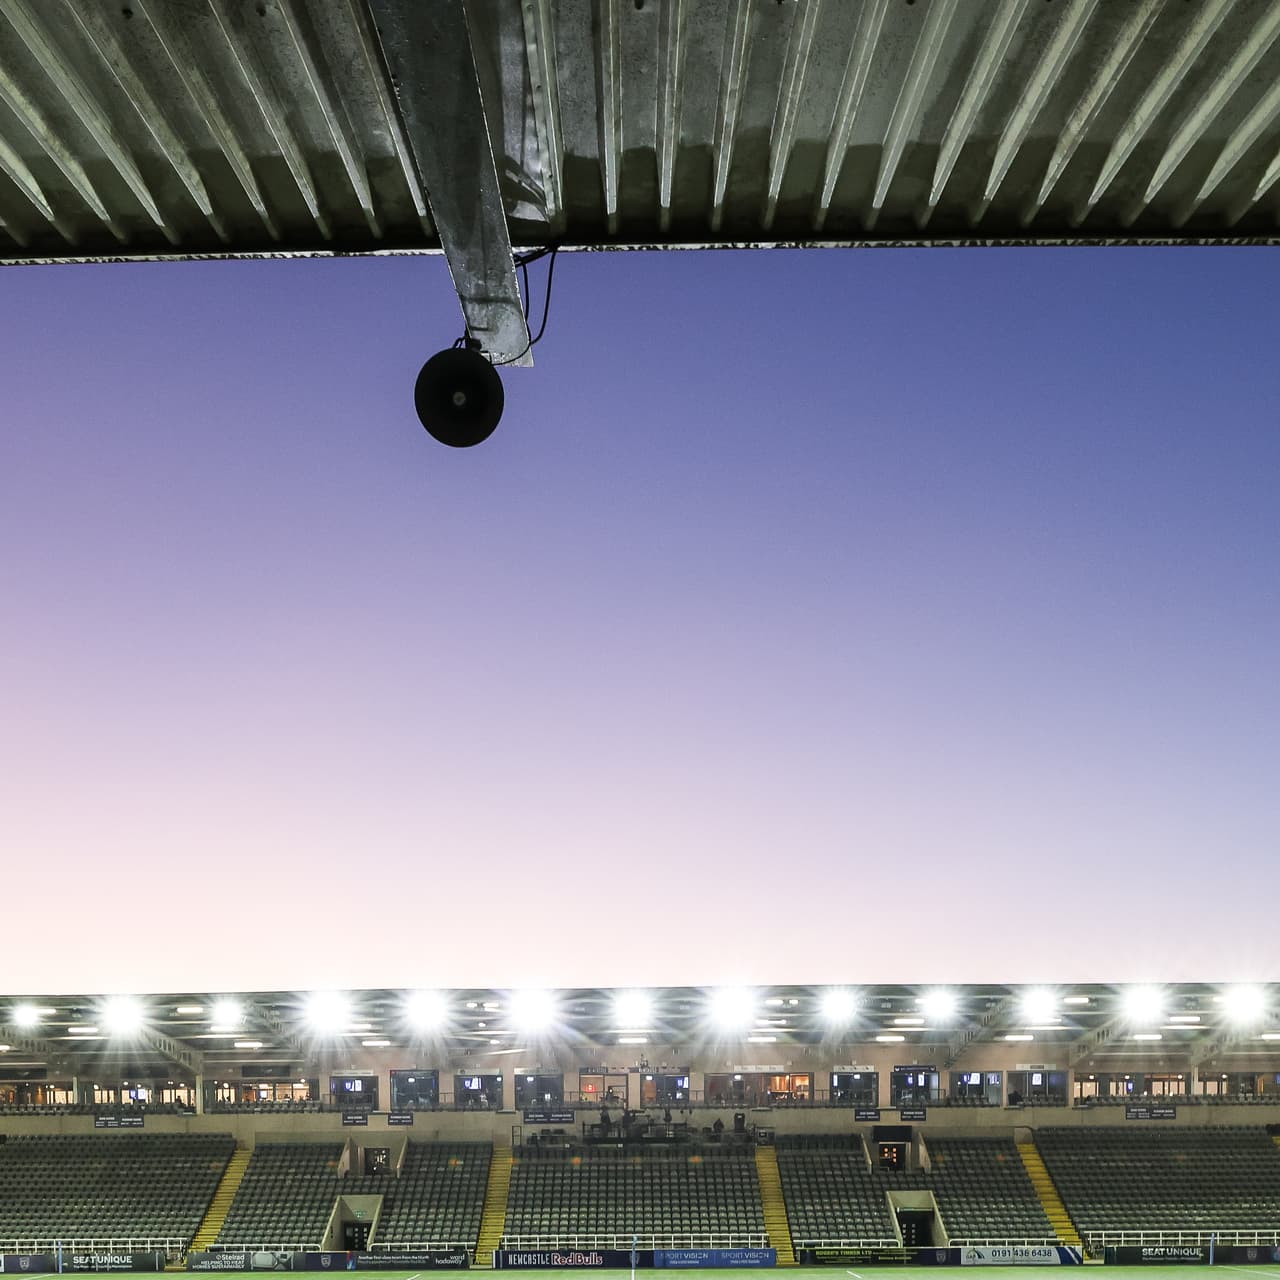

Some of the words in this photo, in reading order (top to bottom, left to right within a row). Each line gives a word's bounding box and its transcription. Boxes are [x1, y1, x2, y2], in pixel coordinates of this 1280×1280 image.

[991, 1249, 1010, 1257] 0191
[1013, 1249, 1029, 1257] 438
[1031, 1249, 1052, 1257] 6438
[1142, 1248, 1165, 1256] SEAT
[1166, 1248, 1202, 1256] UNIQUE
[73, 1255, 96, 1264] SEAT
[97, 1255, 133, 1264] UNIQUE
[508, 1254, 550, 1265] NEWCASTLE
[551, 1252, 575, 1265] Red
[575, 1252, 603, 1265] Bulls
